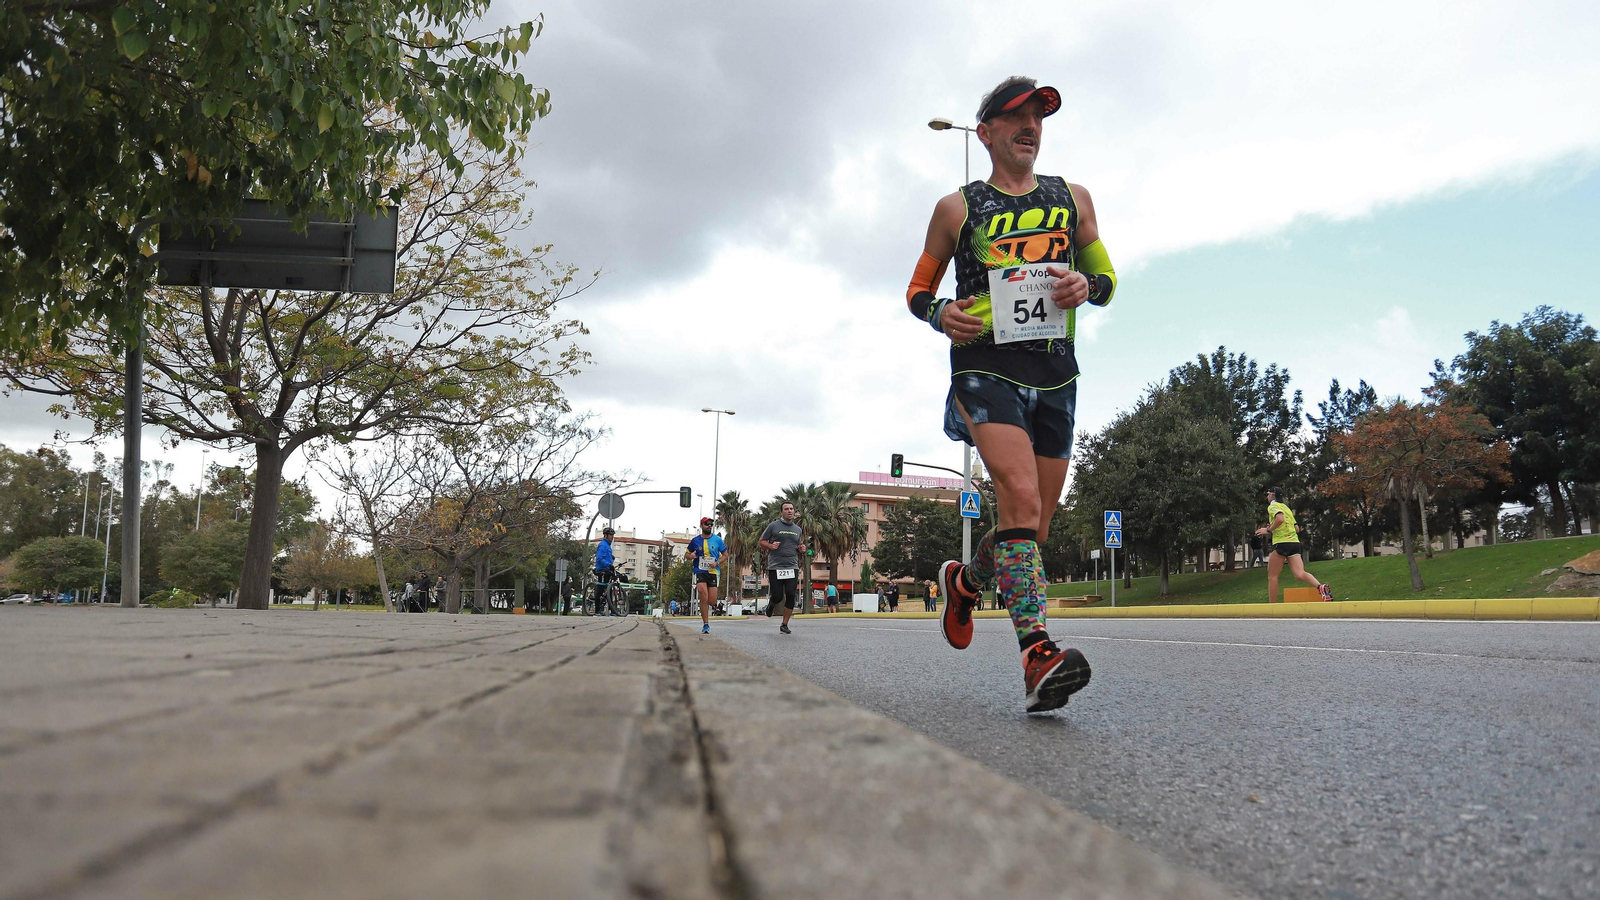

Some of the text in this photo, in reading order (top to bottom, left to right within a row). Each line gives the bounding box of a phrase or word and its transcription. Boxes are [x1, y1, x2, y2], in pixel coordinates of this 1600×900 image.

[985, 232, 1069, 267] STOP
[1029, 268, 1050, 278] Vop
[1019, 282, 1053, 293] CHANO
[1013, 297, 1047, 325] 54
